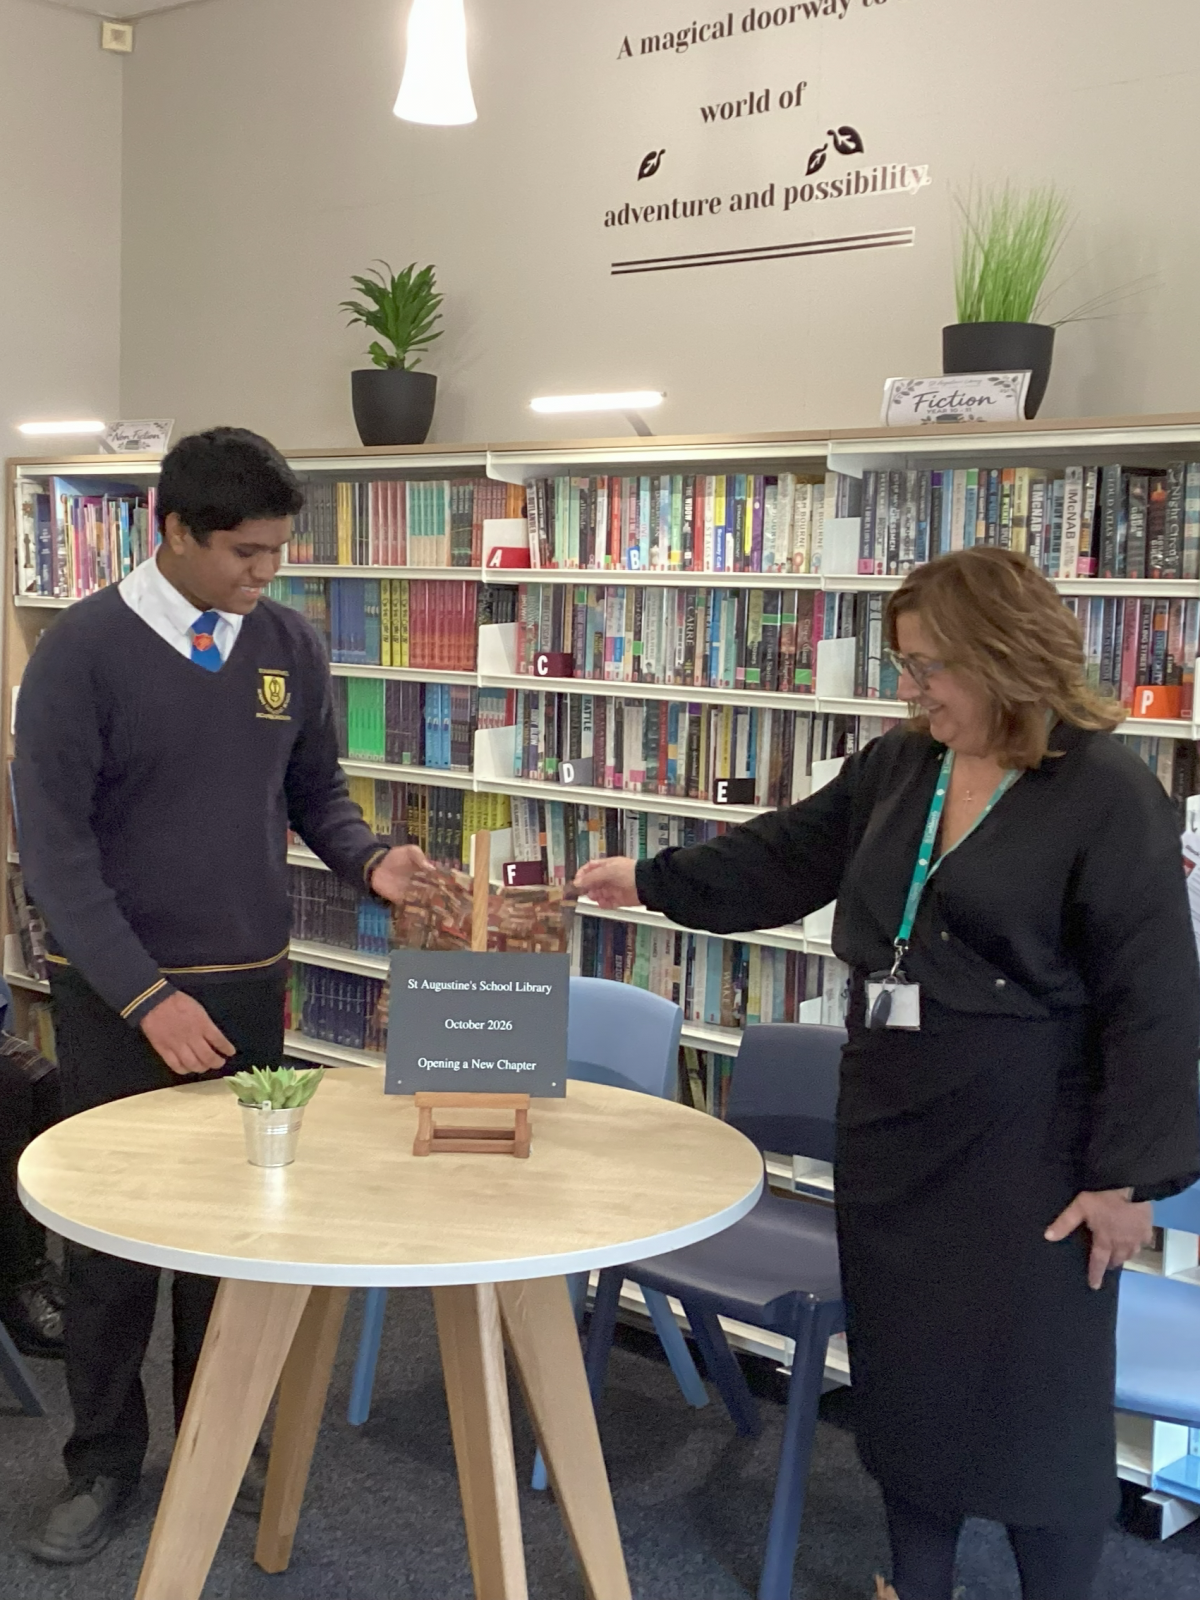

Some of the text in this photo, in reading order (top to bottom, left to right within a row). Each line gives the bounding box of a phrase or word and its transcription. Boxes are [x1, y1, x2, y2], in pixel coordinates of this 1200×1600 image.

[616, 0, 851, 60] A magical doorway
[700, 81, 807, 123] world of
[604, 196, 721, 228] adventure
[729, 183, 775, 212] and
[912, 389, 998, 413] Fiction
[1031, 491, 1043, 531] McNAB
[1169, 486, 1181, 519] Night
[1066, 492, 1078, 539] McNAB
[490, 549, 502, 567] A
[630, 549, 640, 570] B
[686, 606, 695, 646] CARRÉ
[537, 655, 548, 675] C
[1141, 690, 1154, 714] P
[846, 733, 854, 754] JAMES
[562, 763, 574, 783] D
[717, 781, 728, 802] E
[507, 864, 516, 884] F
[408, 978, 552, 995] St Augustine's School Library
[445, 1018, 513, 1031] October 2026
[418, 1057, 537, 1072] Opening a New Chapter
